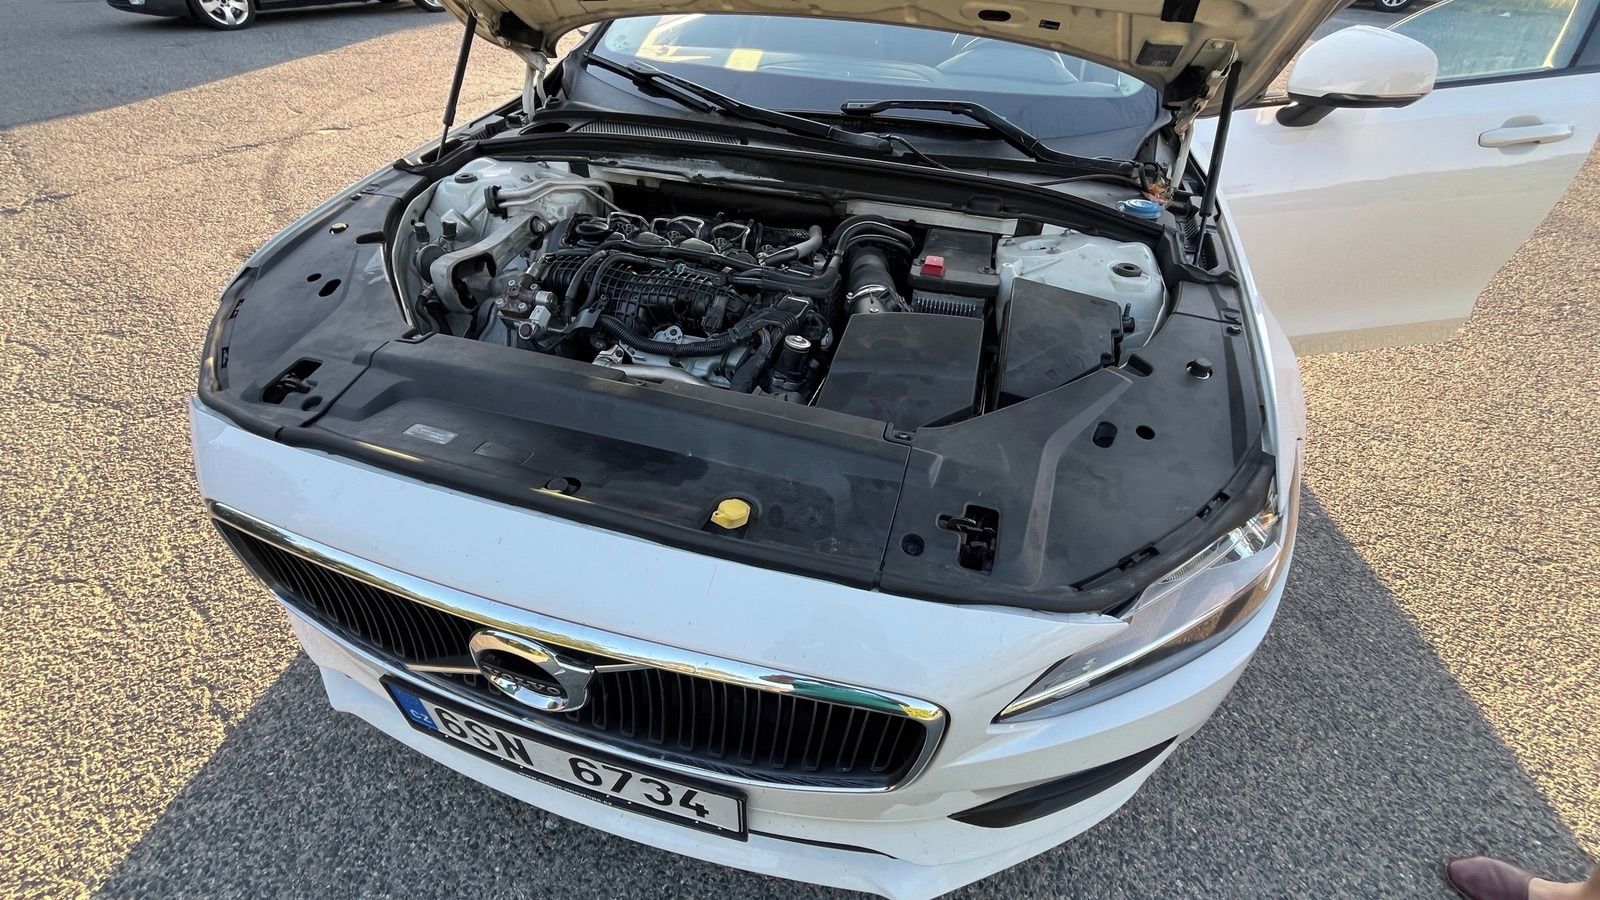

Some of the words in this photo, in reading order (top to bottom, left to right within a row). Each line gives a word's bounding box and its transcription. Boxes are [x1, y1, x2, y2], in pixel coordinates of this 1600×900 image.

[410, 709, 433, 724] CZ
[434, 707, 535, 766] 6SN
[568, 757, 710, 818] 6734
